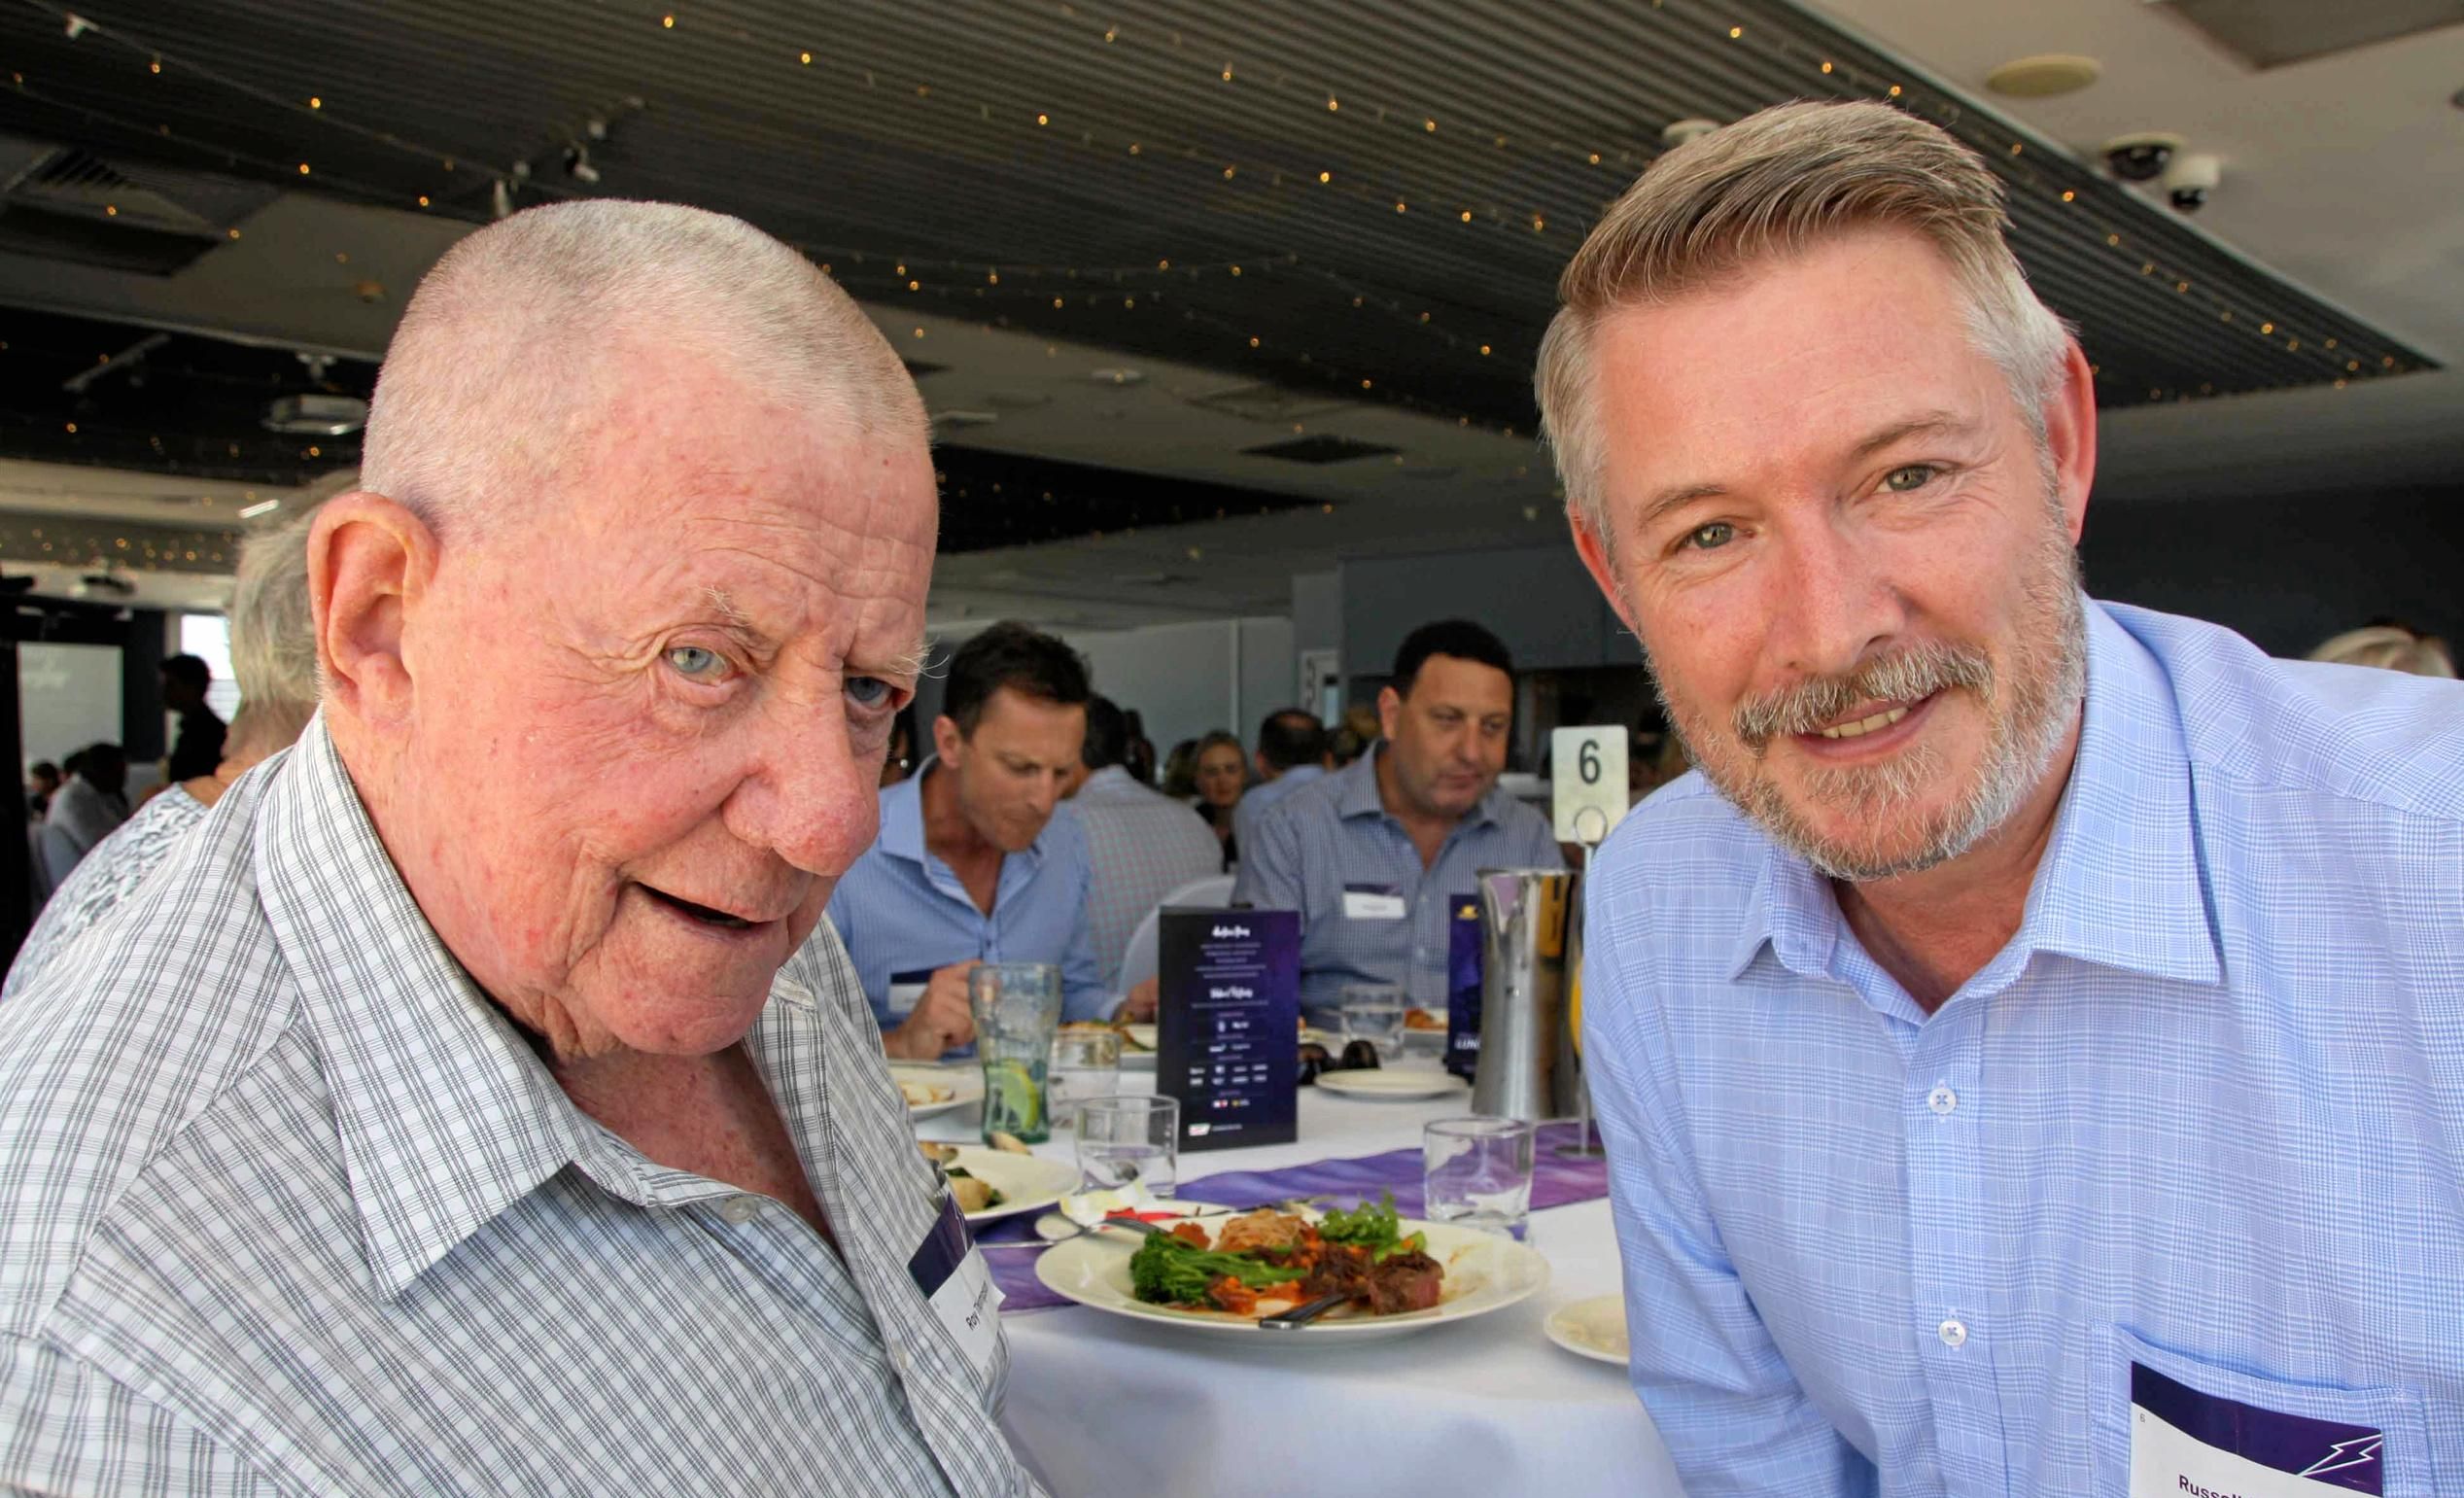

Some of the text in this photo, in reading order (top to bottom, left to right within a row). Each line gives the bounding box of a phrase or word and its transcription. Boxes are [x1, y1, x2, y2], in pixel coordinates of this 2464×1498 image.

[1579, 739, 1601, 785] 6
[965, 1310, 981, 1331] Roy
[2139, 1412, 2146, 1423] 6
